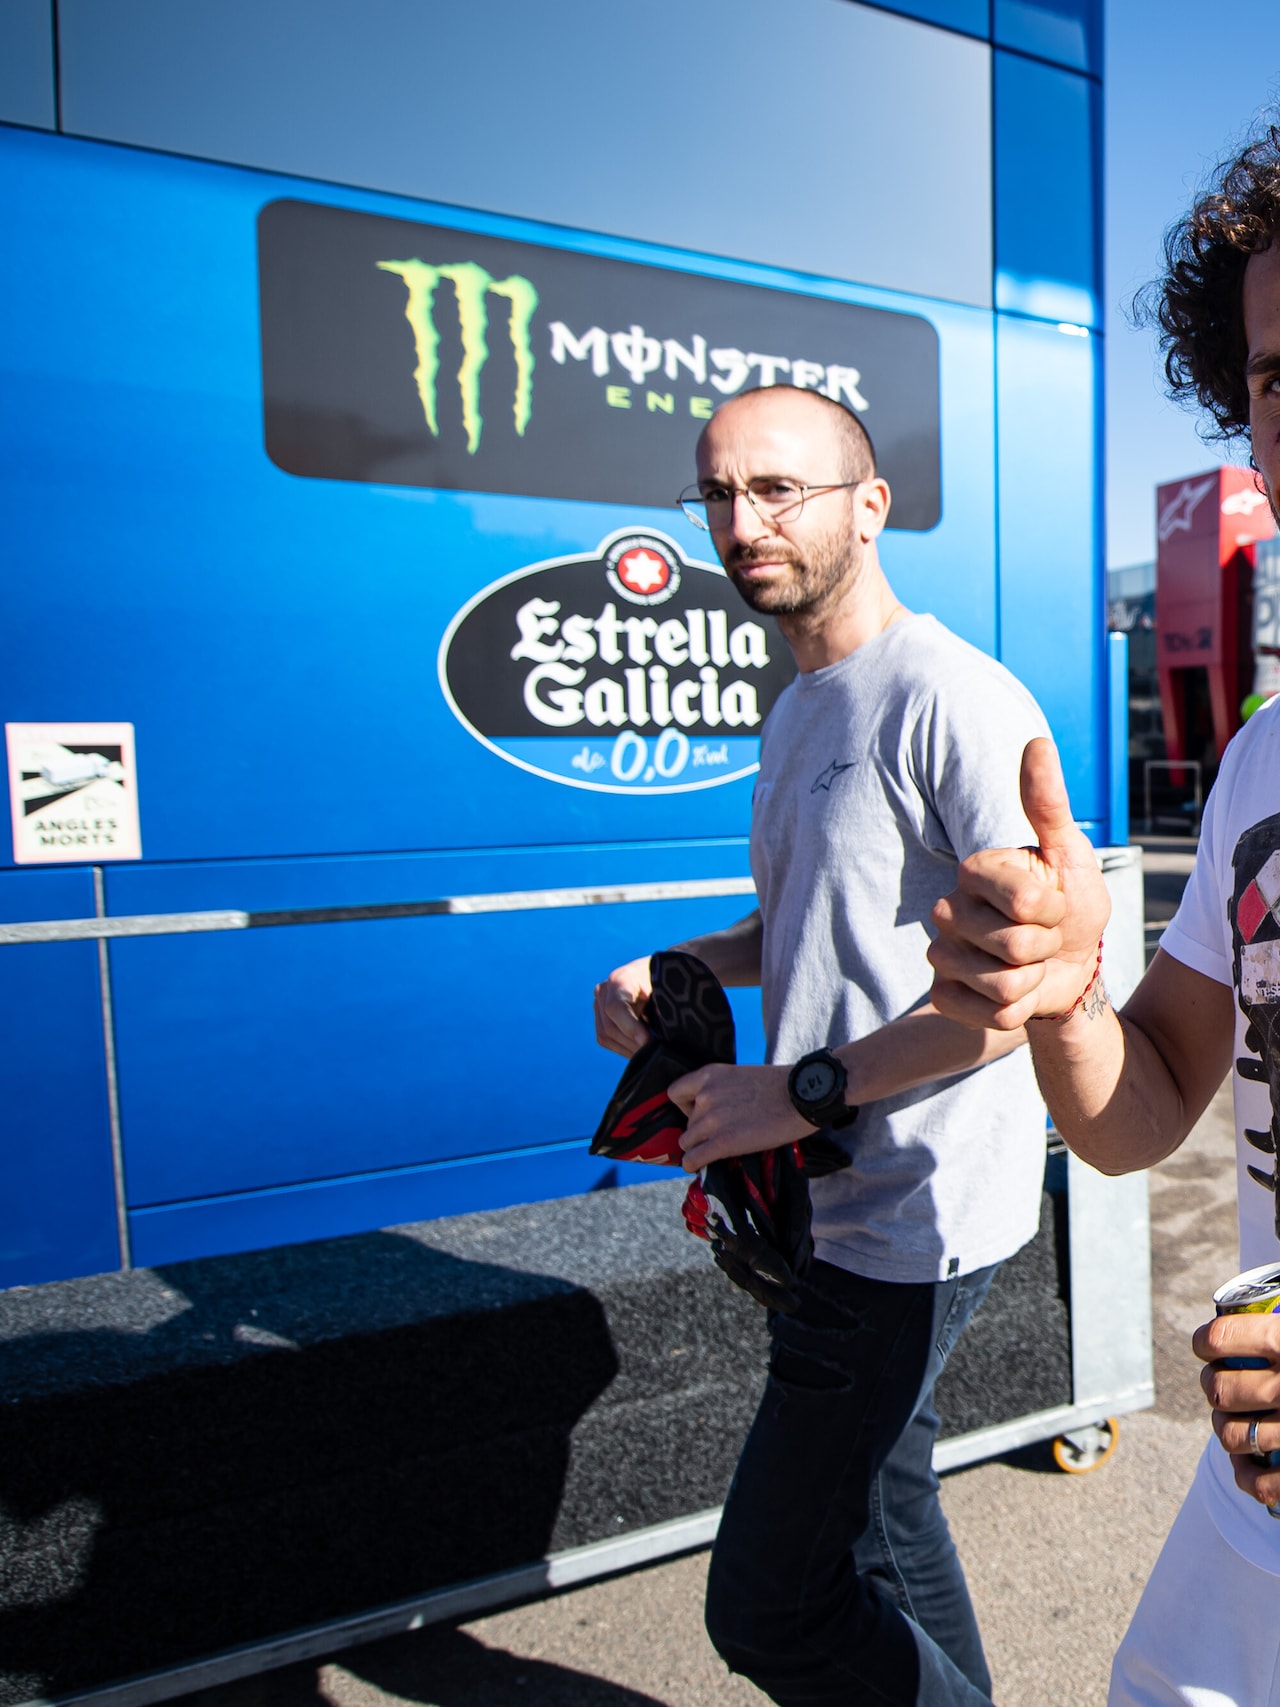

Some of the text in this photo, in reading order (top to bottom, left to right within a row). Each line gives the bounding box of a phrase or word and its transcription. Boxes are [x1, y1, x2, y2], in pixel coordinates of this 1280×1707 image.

[549, 320, 869, 411] MONSTER
[606, 384, 714, 419] ENE
[510, 597, 771, 669] Estrella
[523, 662, 762, 728] Galicia
[610, 726, 690, 783] 0,0
[35, 818, 118, 832] ANGLES
[40, 834, 116, 846] MORTS
